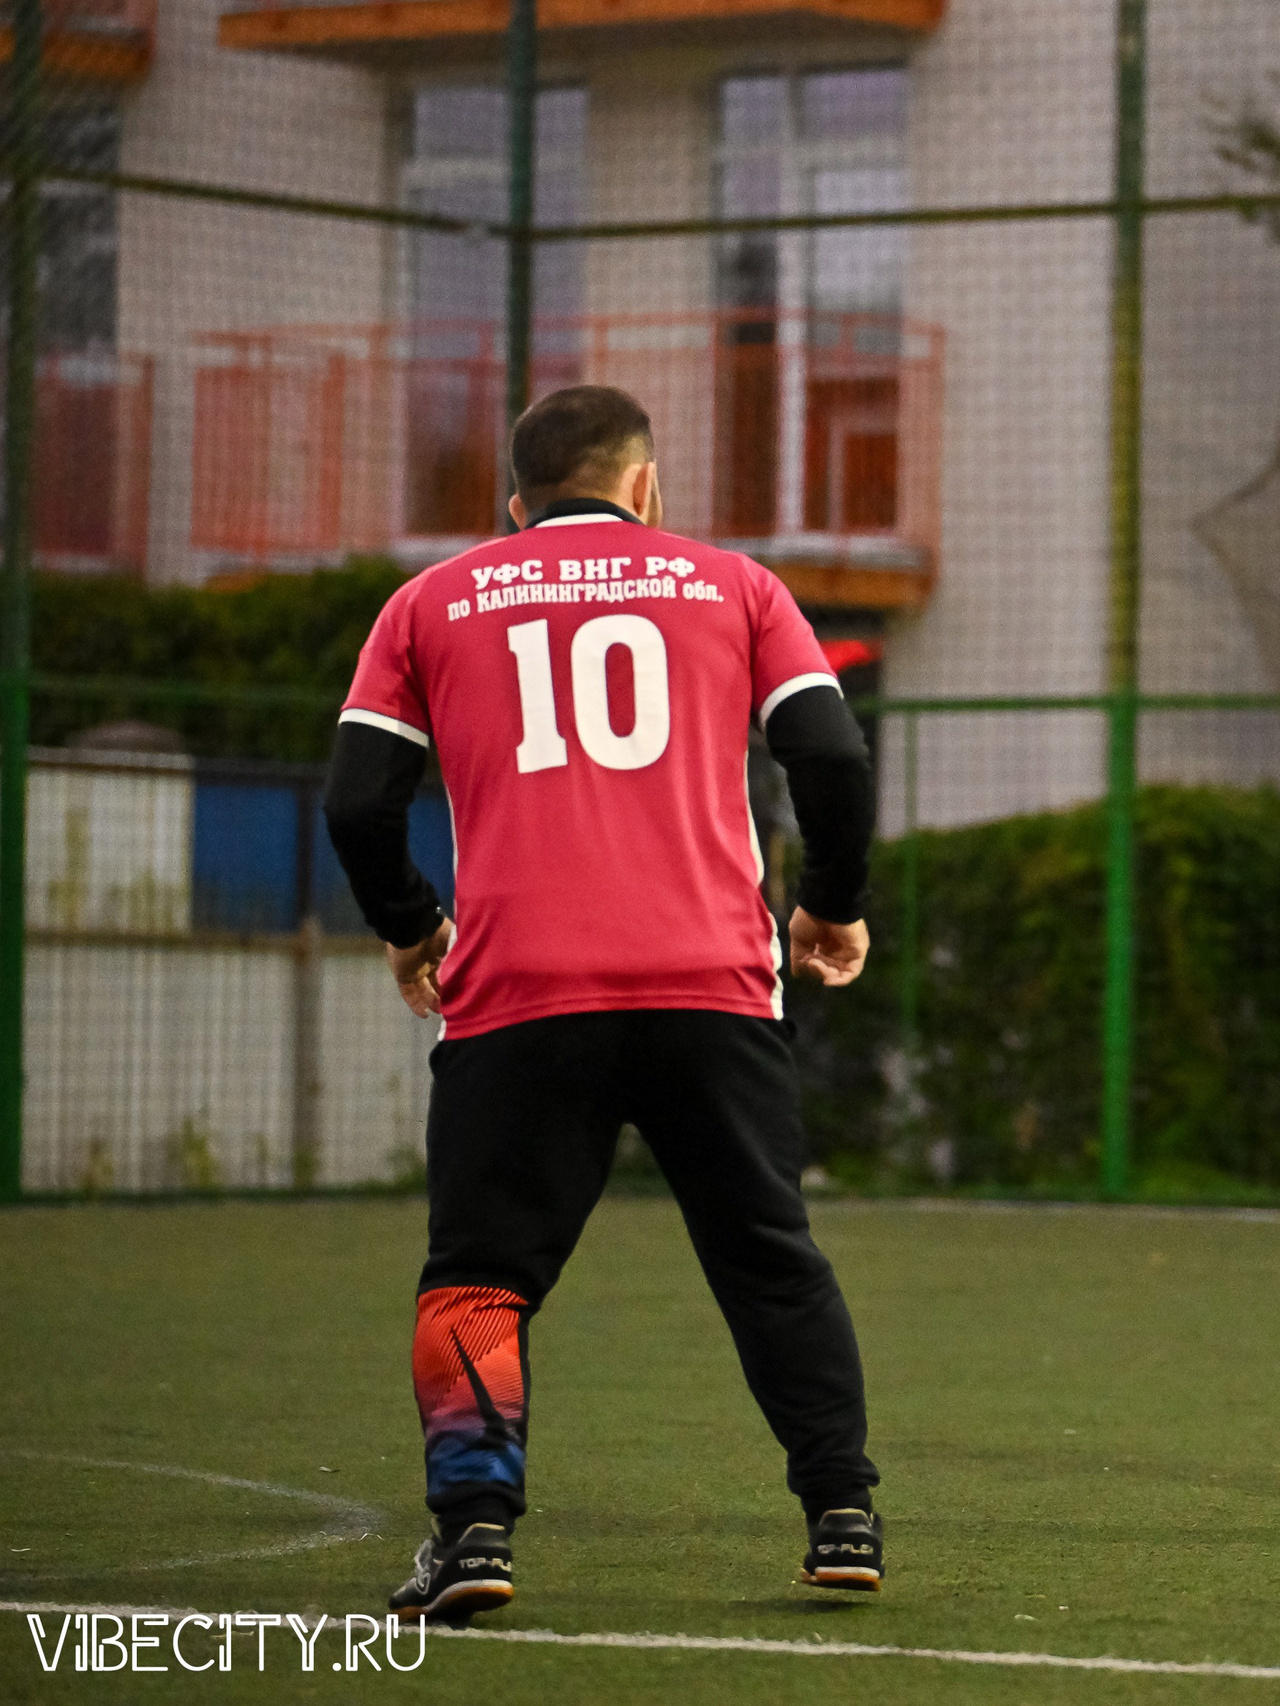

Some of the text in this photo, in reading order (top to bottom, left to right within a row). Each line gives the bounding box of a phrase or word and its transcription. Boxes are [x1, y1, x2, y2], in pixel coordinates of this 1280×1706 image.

[471, 556, 696, 590] УФС ВНГ РФ
[476, 575, 677, 613] КАЛИНИНГРАДСКОЙ
[507, 614, 671, 774] 10
